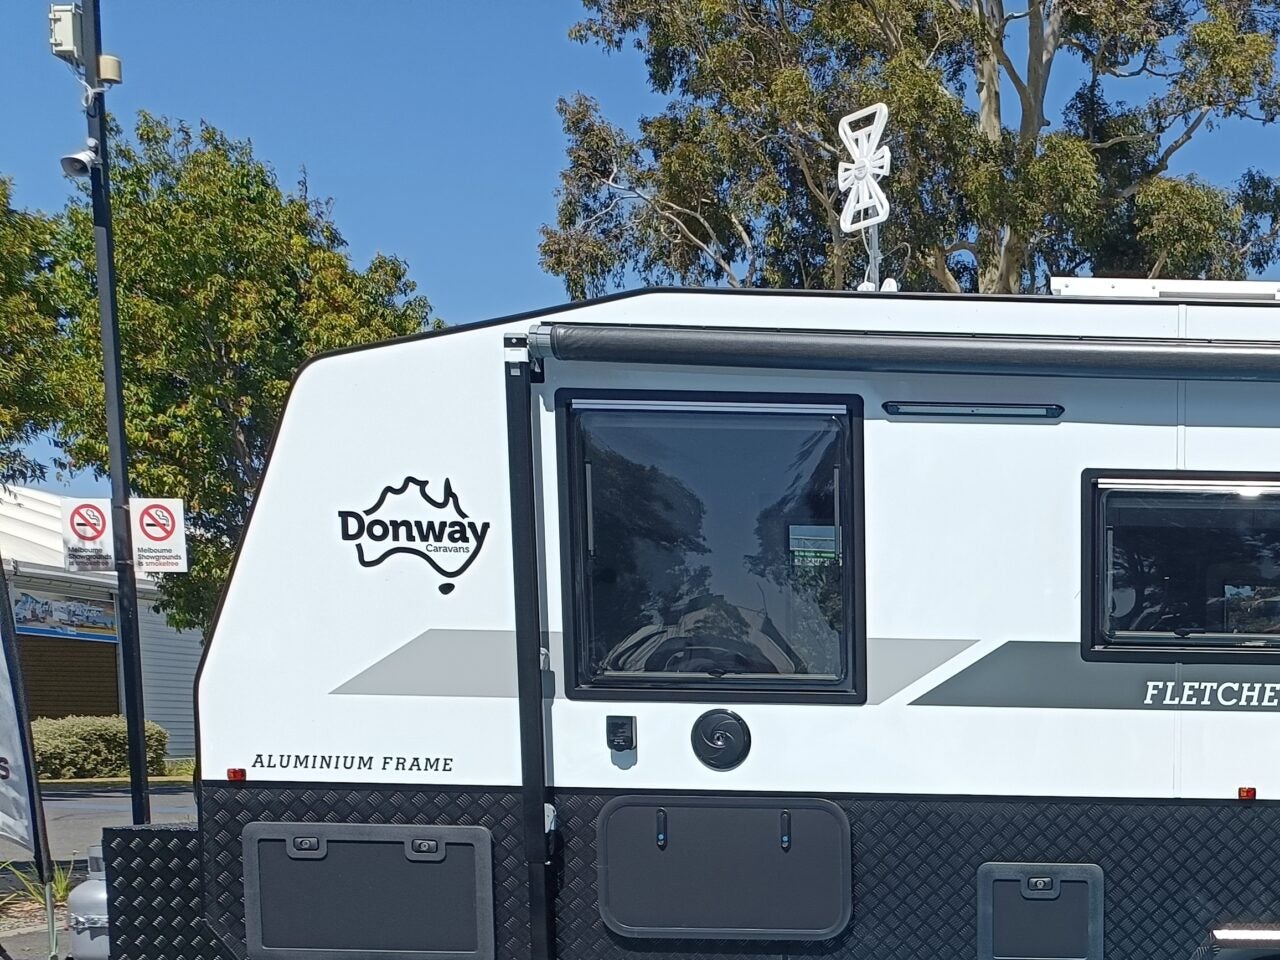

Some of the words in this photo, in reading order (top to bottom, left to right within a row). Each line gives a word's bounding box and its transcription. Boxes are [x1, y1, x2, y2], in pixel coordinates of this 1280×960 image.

[338, 510, 490, 547] Donway
[425, 544, 470, 554] Caravans
[137, 553, 182, 561] Showgrounds
[251, 754, 374, 770] ALUMINIUM
[381, 756, 454, 772] FRAME
